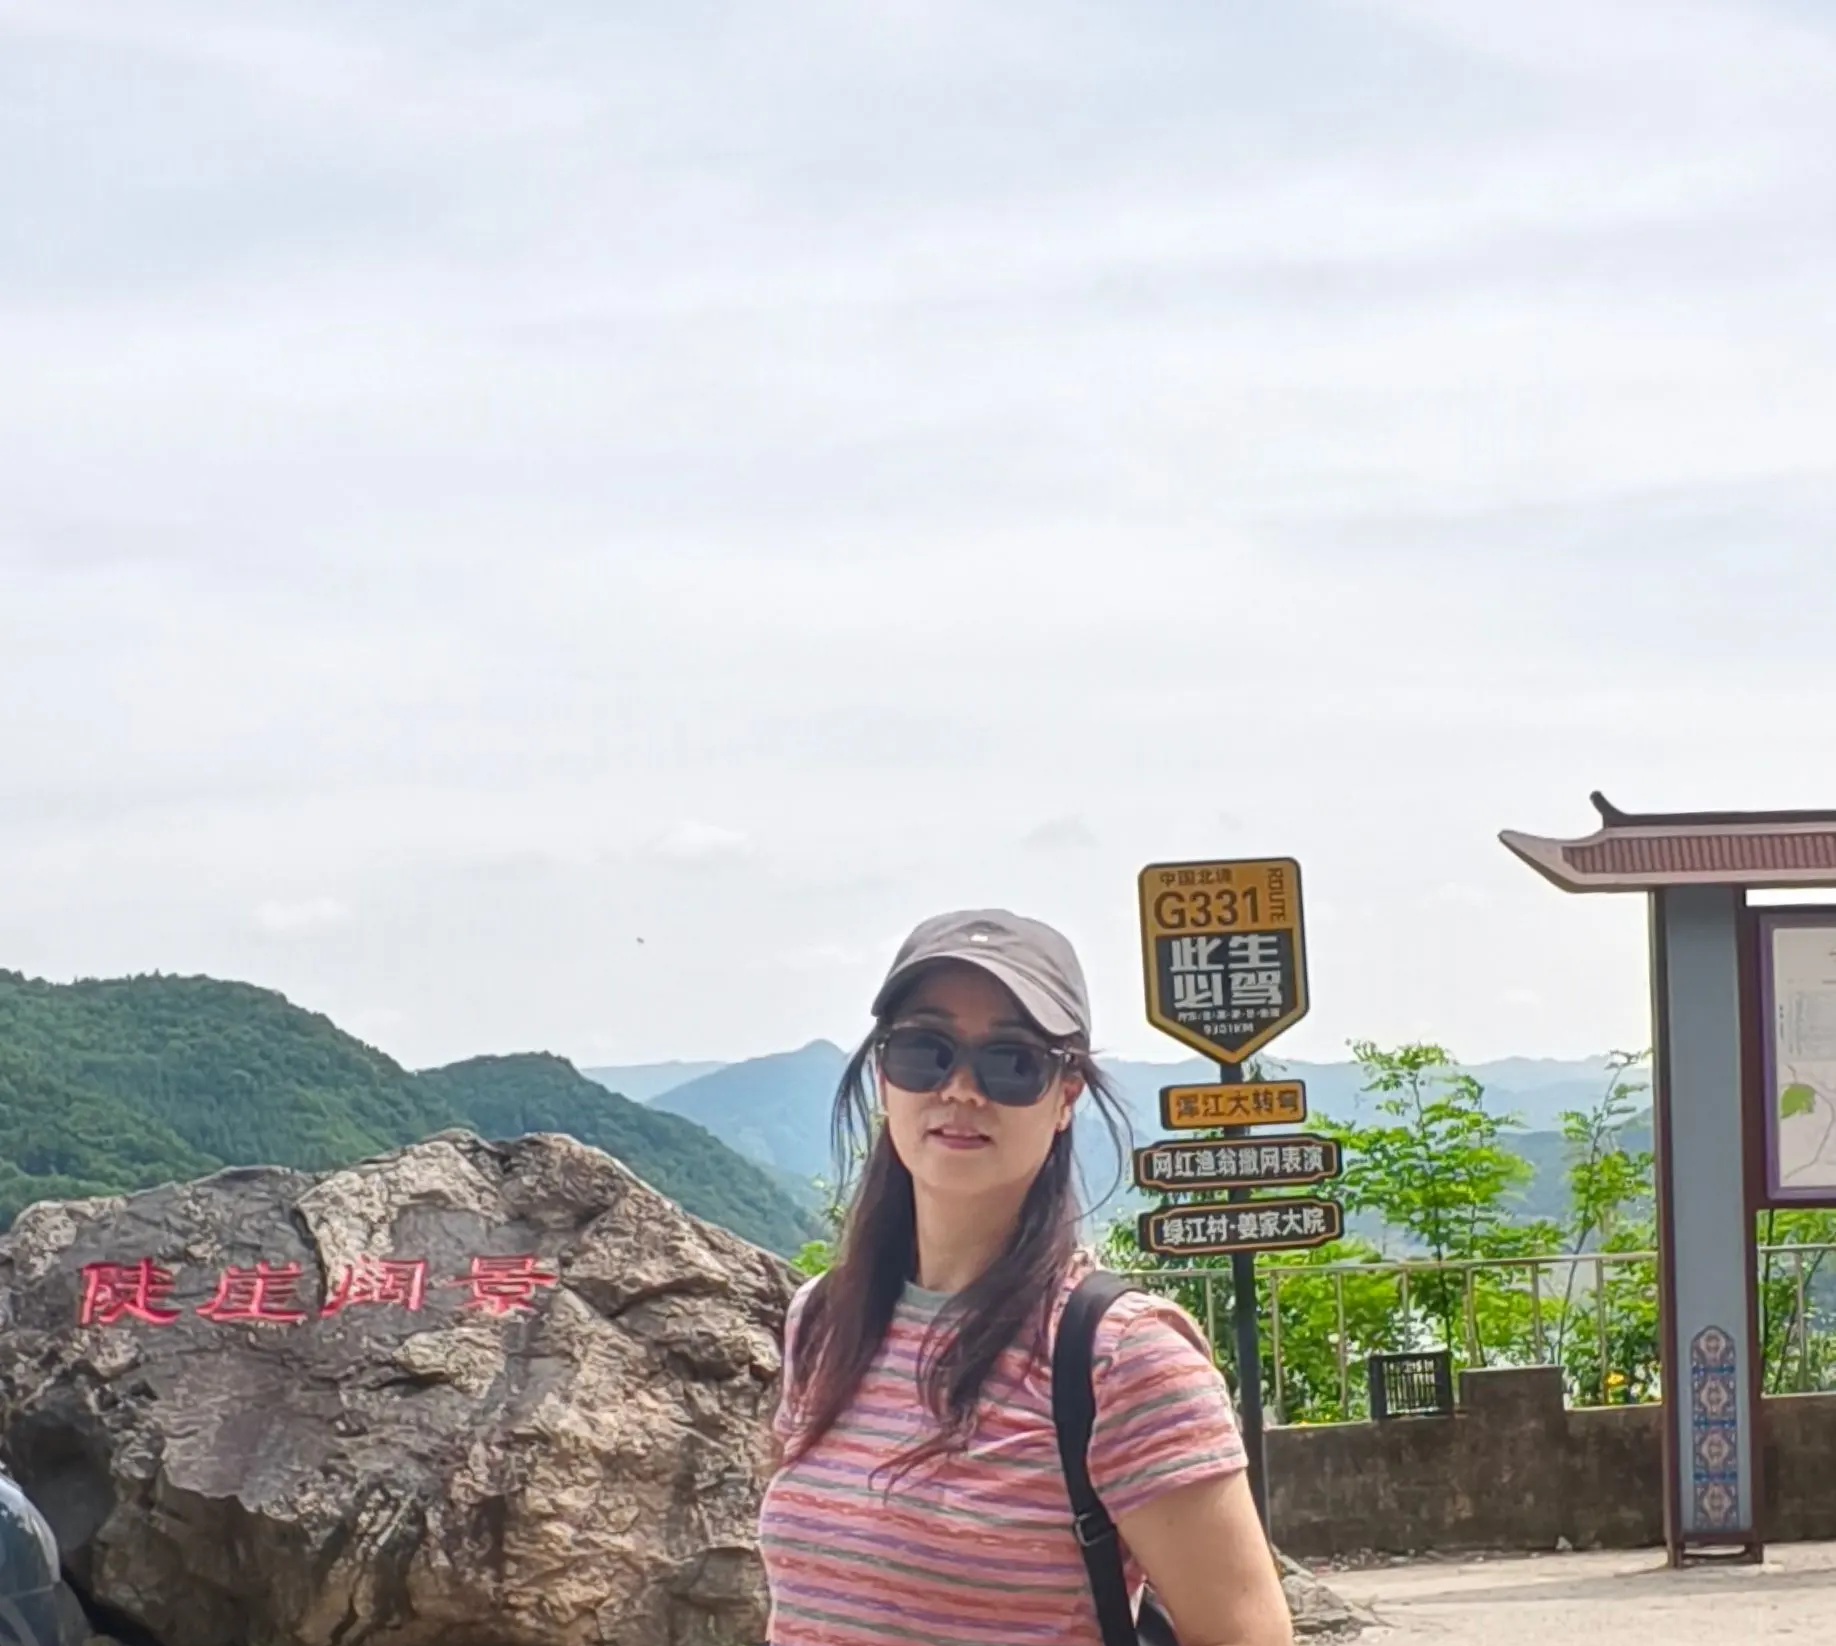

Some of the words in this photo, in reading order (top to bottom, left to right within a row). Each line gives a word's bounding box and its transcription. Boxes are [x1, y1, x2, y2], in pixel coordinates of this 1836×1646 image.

[1154, 886, 1259, 929] G331
[1267, 867, 1286, 924] ROUTE
[1170, 934, 1282, 973] 此生
[1173, 970, 1283, 1009] 必驾
[1152, 1146, 1324, 1179] 网红渔翁撒网表演
